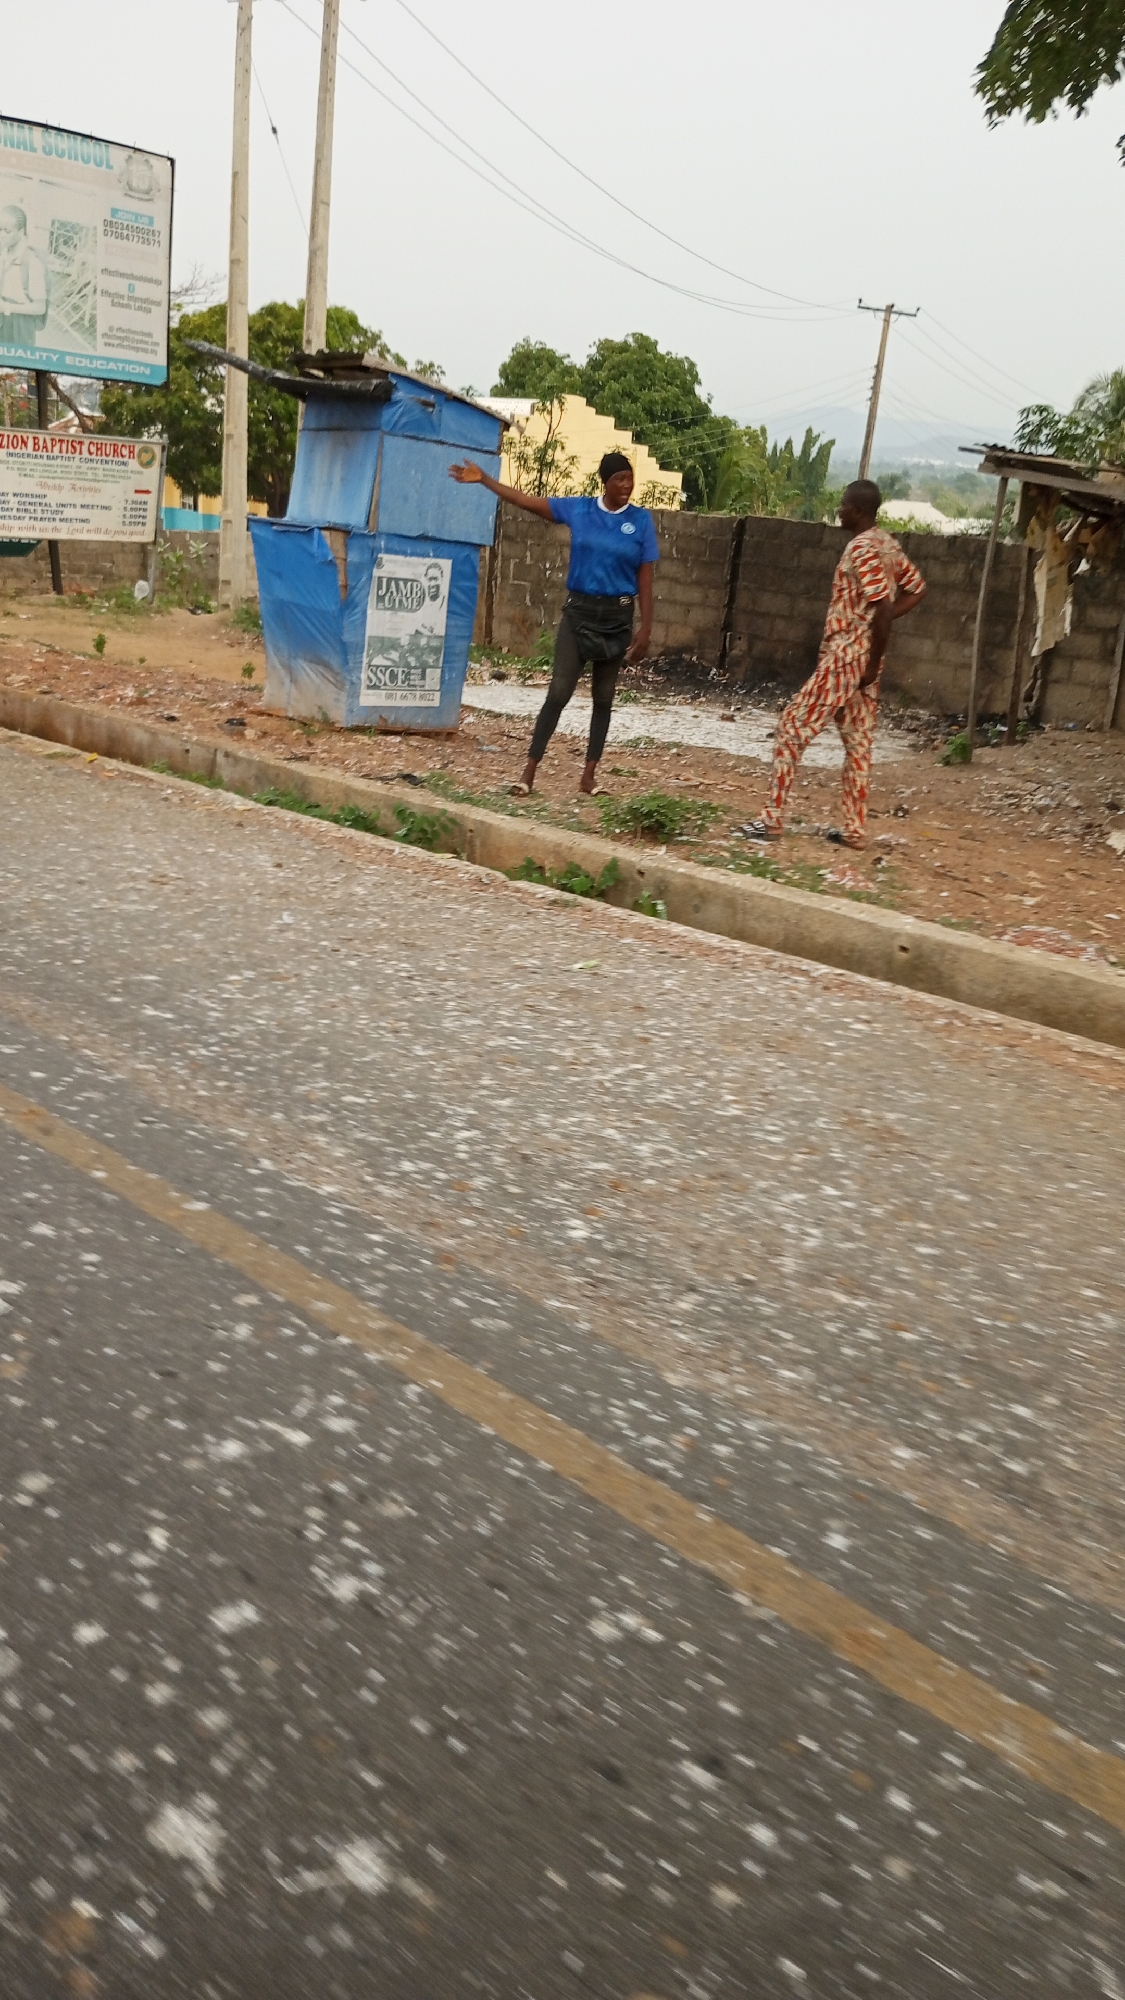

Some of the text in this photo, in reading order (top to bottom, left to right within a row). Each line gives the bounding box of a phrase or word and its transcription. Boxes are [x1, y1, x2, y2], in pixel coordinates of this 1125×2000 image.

[0, 121, 38, 153] NAL
[42, 129, 114, 170] SCHOOL
[103, 219, 161, 238] 08034500267
[103, 229, 161, 248] 07064773571
[101, 289, 162, 307] Effective International
[111, 299, 152, 315] Schools Lokoja
[65, 356, 150, 375] EDUCATION
[0, 433, 136, 459] ZION BAPTIST CHURCH
[6, 451, 130, 467] (NIGERIAN BAPTIST CONVENTION)
[12, 492, 48, 500] WORSHIP
[35, 480, 102, 495] Weekly Activities
[16, 507, 38, 515] BIBLE
[40, 508, 64, 516] STUDY
[17, 500, 54, 509] GENERAL
[80, 503, 113, 512] MEETING
[59, 517, 91, 525] MEETING
[18, 523, 37, 533] with
[50, 525, 62, 534] the
[66, 526, 84, 536] Lord
[86, 527, 102, 536] will
[103, 527, 113, 536] do
[112, 530, 128, 538] you
[378, 577, 423, 599] JAMB
[367, 666, 410, 687] SSCE
